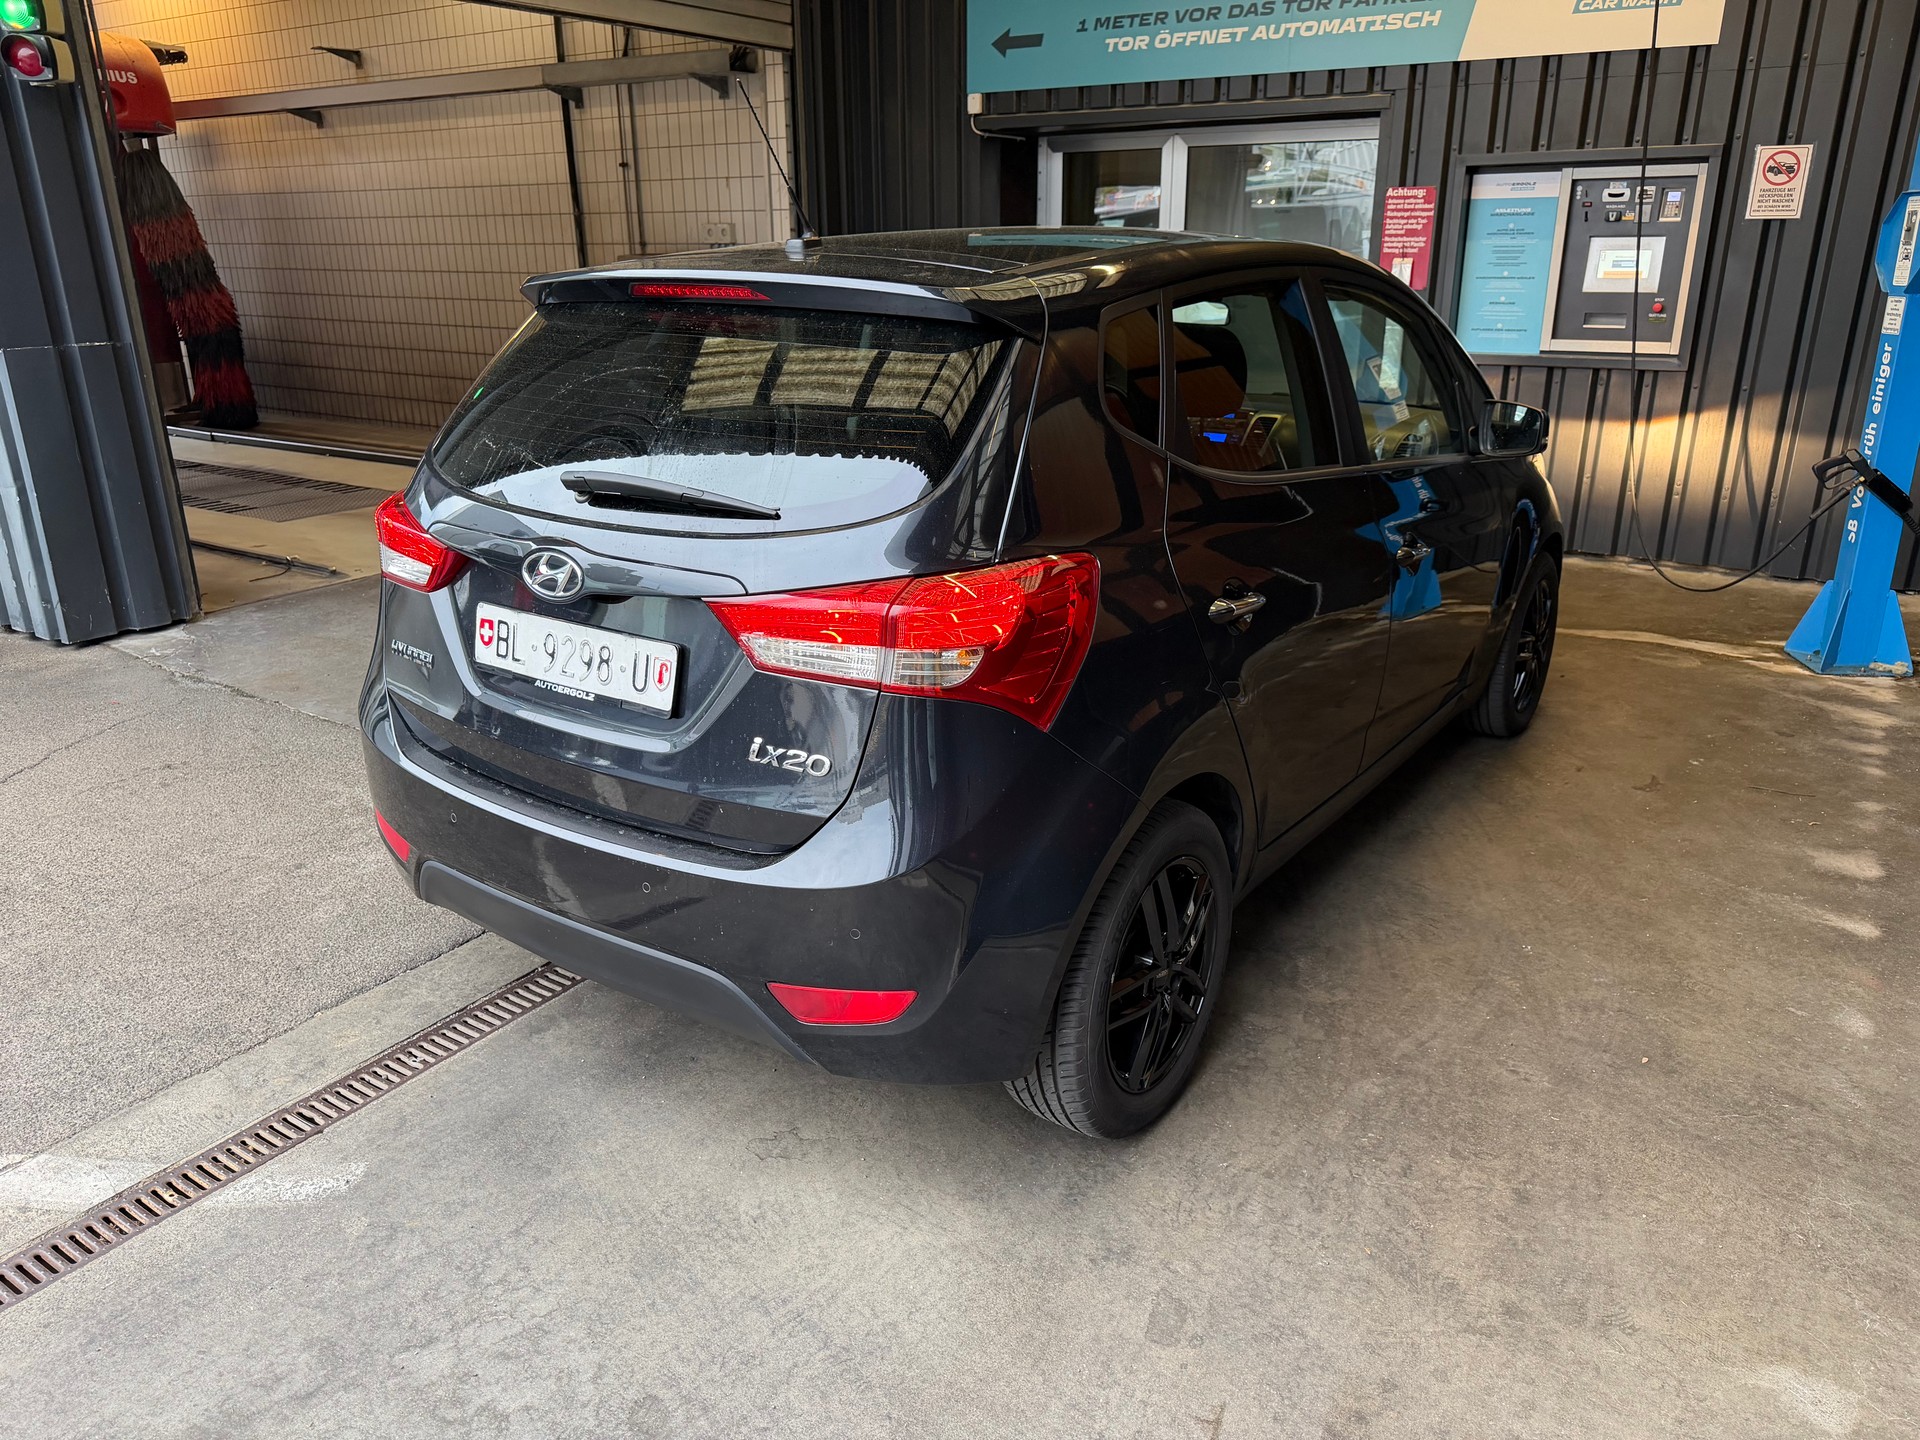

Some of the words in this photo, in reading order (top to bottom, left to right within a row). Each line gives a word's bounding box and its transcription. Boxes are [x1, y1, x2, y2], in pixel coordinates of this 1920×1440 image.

[1076, 18, 1088, 32] 1
[1093, 11, 1169, 31] METER
[1175, 6, 1223, 24] VOR
[1227, 1, 1276, 19] DAS
[1284, 0, 1331, 14] TOR
[1105, 35, 1150, 52] TOR
[1154, 30, 1248, 48] ÖFFNET
[1250, 10, 1442, 41] AUTOMATISCH
[1386, 187, 1427, 198] Achtung:
[1872, 342, 1893, 415] einiger
[496, 619, 526, 666] BL
[543, 631, 614, 686] 9298
[631, 650, 652, 694] U
[534, 679, 596, 702] AUTOERGOLZ
[747, 736, 832, 778] ix20
